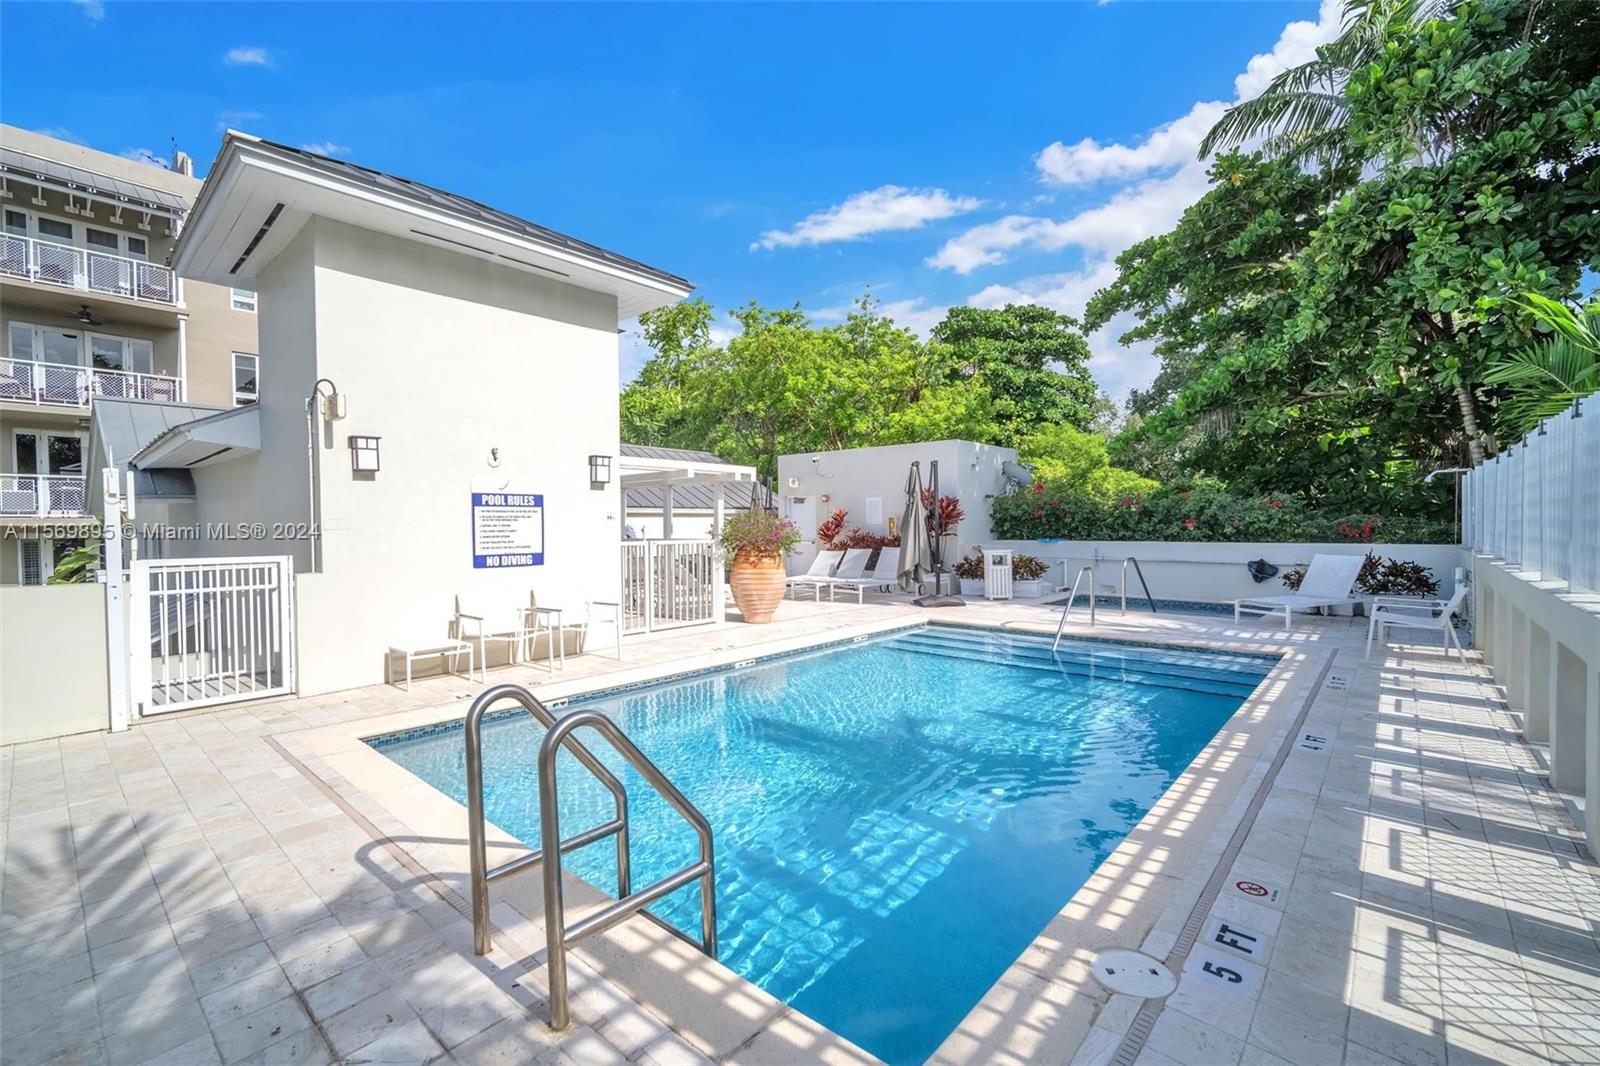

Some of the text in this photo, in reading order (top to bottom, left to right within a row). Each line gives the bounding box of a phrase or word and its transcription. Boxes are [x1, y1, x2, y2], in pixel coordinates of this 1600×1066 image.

[481, 494, 535, 506] POOL RULES
[486, 554, 533, 567] NO DIVING
[1202, 923, 1257, 984] 5 FT
